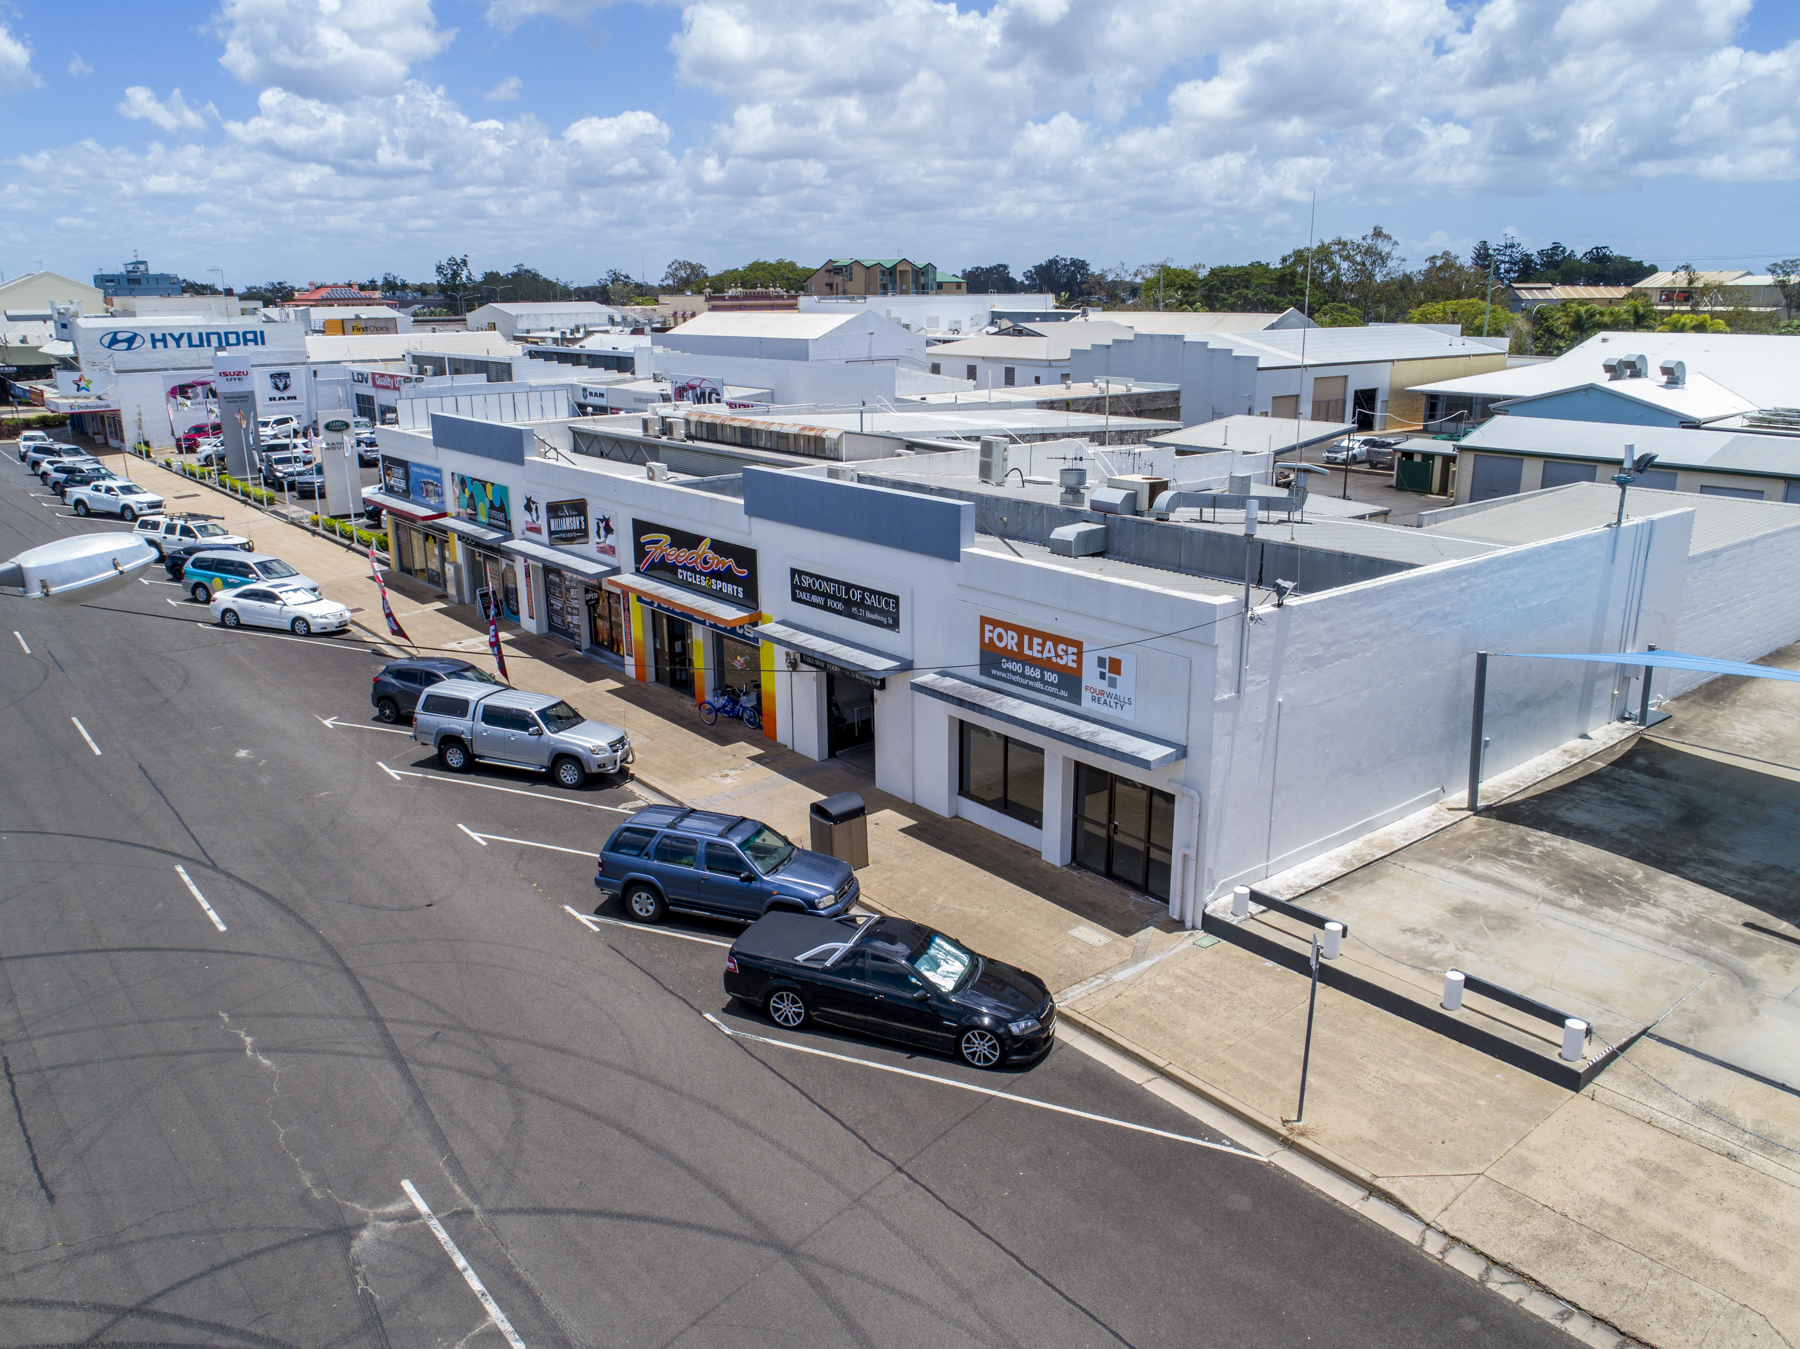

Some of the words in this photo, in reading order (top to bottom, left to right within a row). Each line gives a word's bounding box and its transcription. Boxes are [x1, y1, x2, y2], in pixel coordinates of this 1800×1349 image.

[149, 330, 266, 349] HYUNDAI
[351, 371, 370, 384] LDV
[374, 374, 394, 389] Quality
[589, 391, 605, 399] RAM
[550, 516, 585, 531] WILLIAMSON'S
[640, 534, 749, 578] Freedom
[585, 592, 599, 601] OPEN
[793, 573, 801, 586] A
[801, 574, 849, 599] SPOONFUL
[849, 588, 864, 603] OF
[864, 591, 897, 612] SAUCE
[795, 589, 826, 606] TAKEAWAY
[827, 598, 845, 611] FOOD
[859, 608, 866, 616] 21
[887, 616, 893, 625] St
[984, 623, 1019, 652] FOR
[1023, 634, 1078, 669] LEASE
[1001, 658, 1023, 674] 0400
[1024, 665, 1042, 679] 868
[1043, 670, 1059, 684] 100
[990, 668, 1069, 697] www.thefourwalls.com.au
[1091, 694, 1126, 711] REALTY
